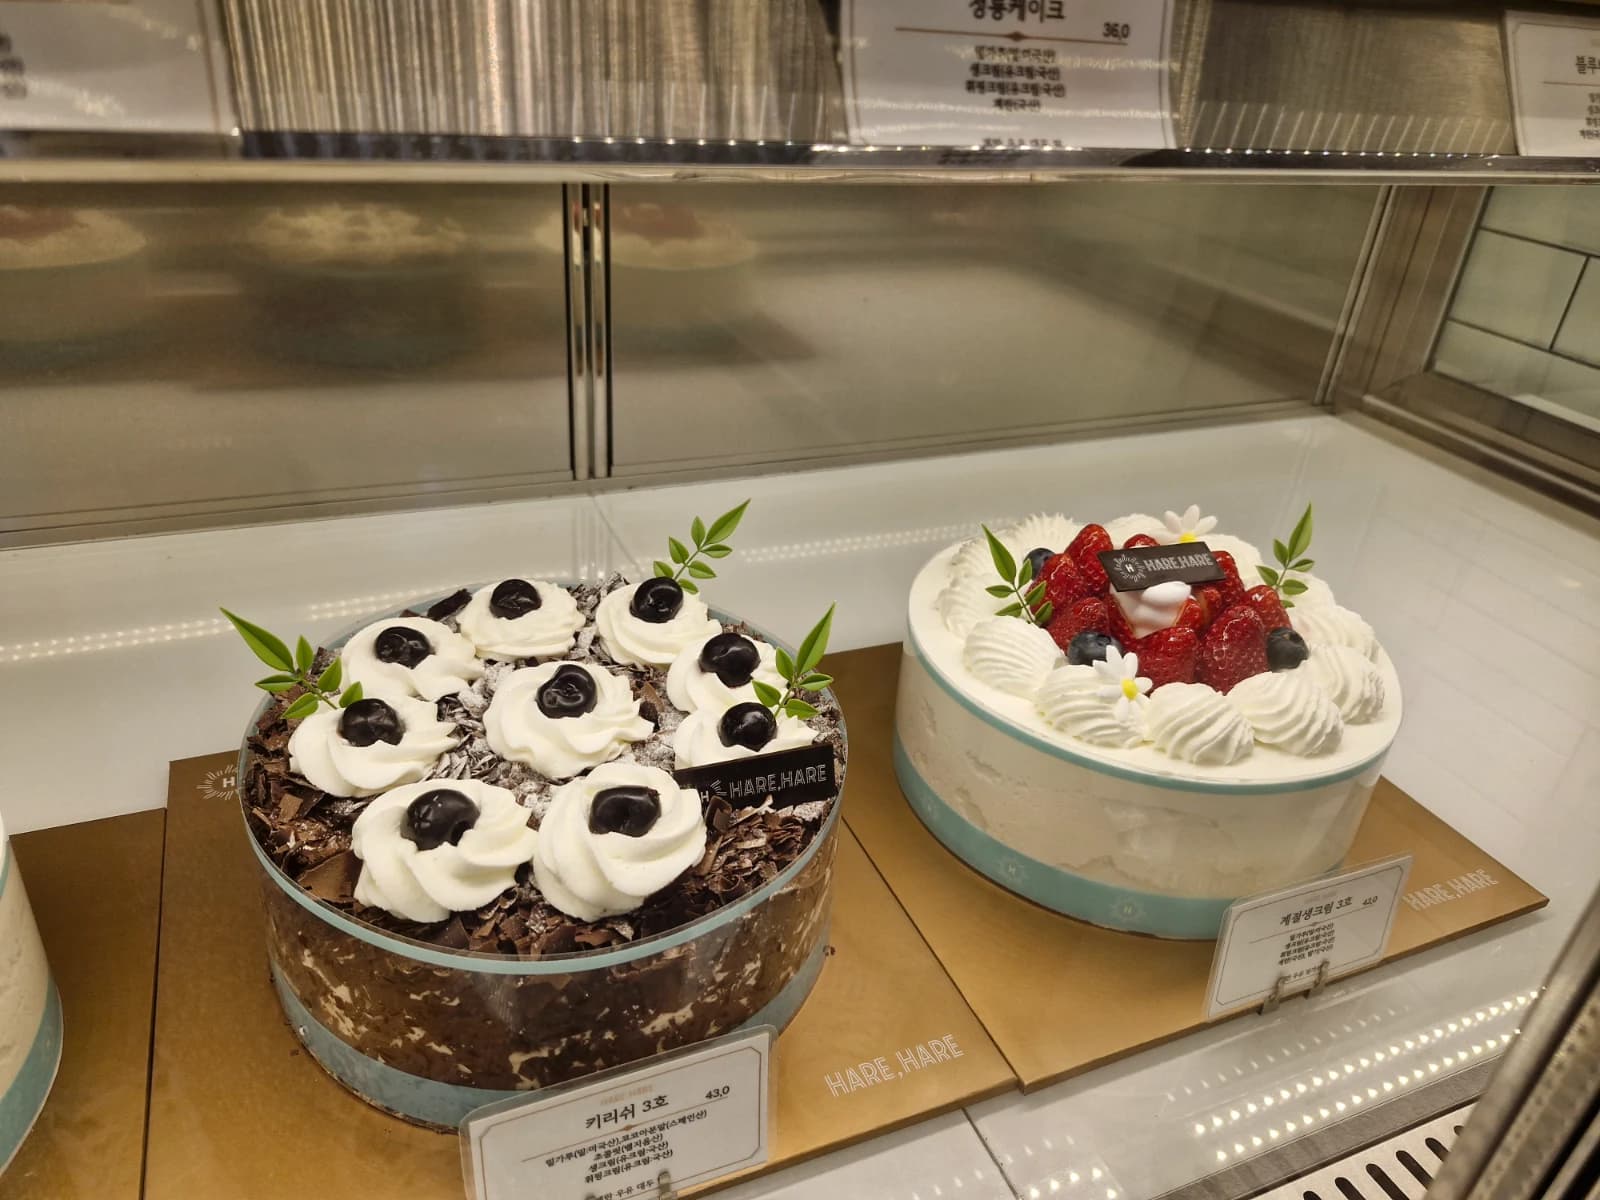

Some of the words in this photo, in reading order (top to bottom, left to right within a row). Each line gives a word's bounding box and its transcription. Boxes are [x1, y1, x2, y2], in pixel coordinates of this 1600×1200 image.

[1576, 55, 1600, 75] 블루
[222, 776, 235, 788] H
[585, 1103, 635, 1129] 키리쉬
[642, 1095, 669, 1113] 3호
